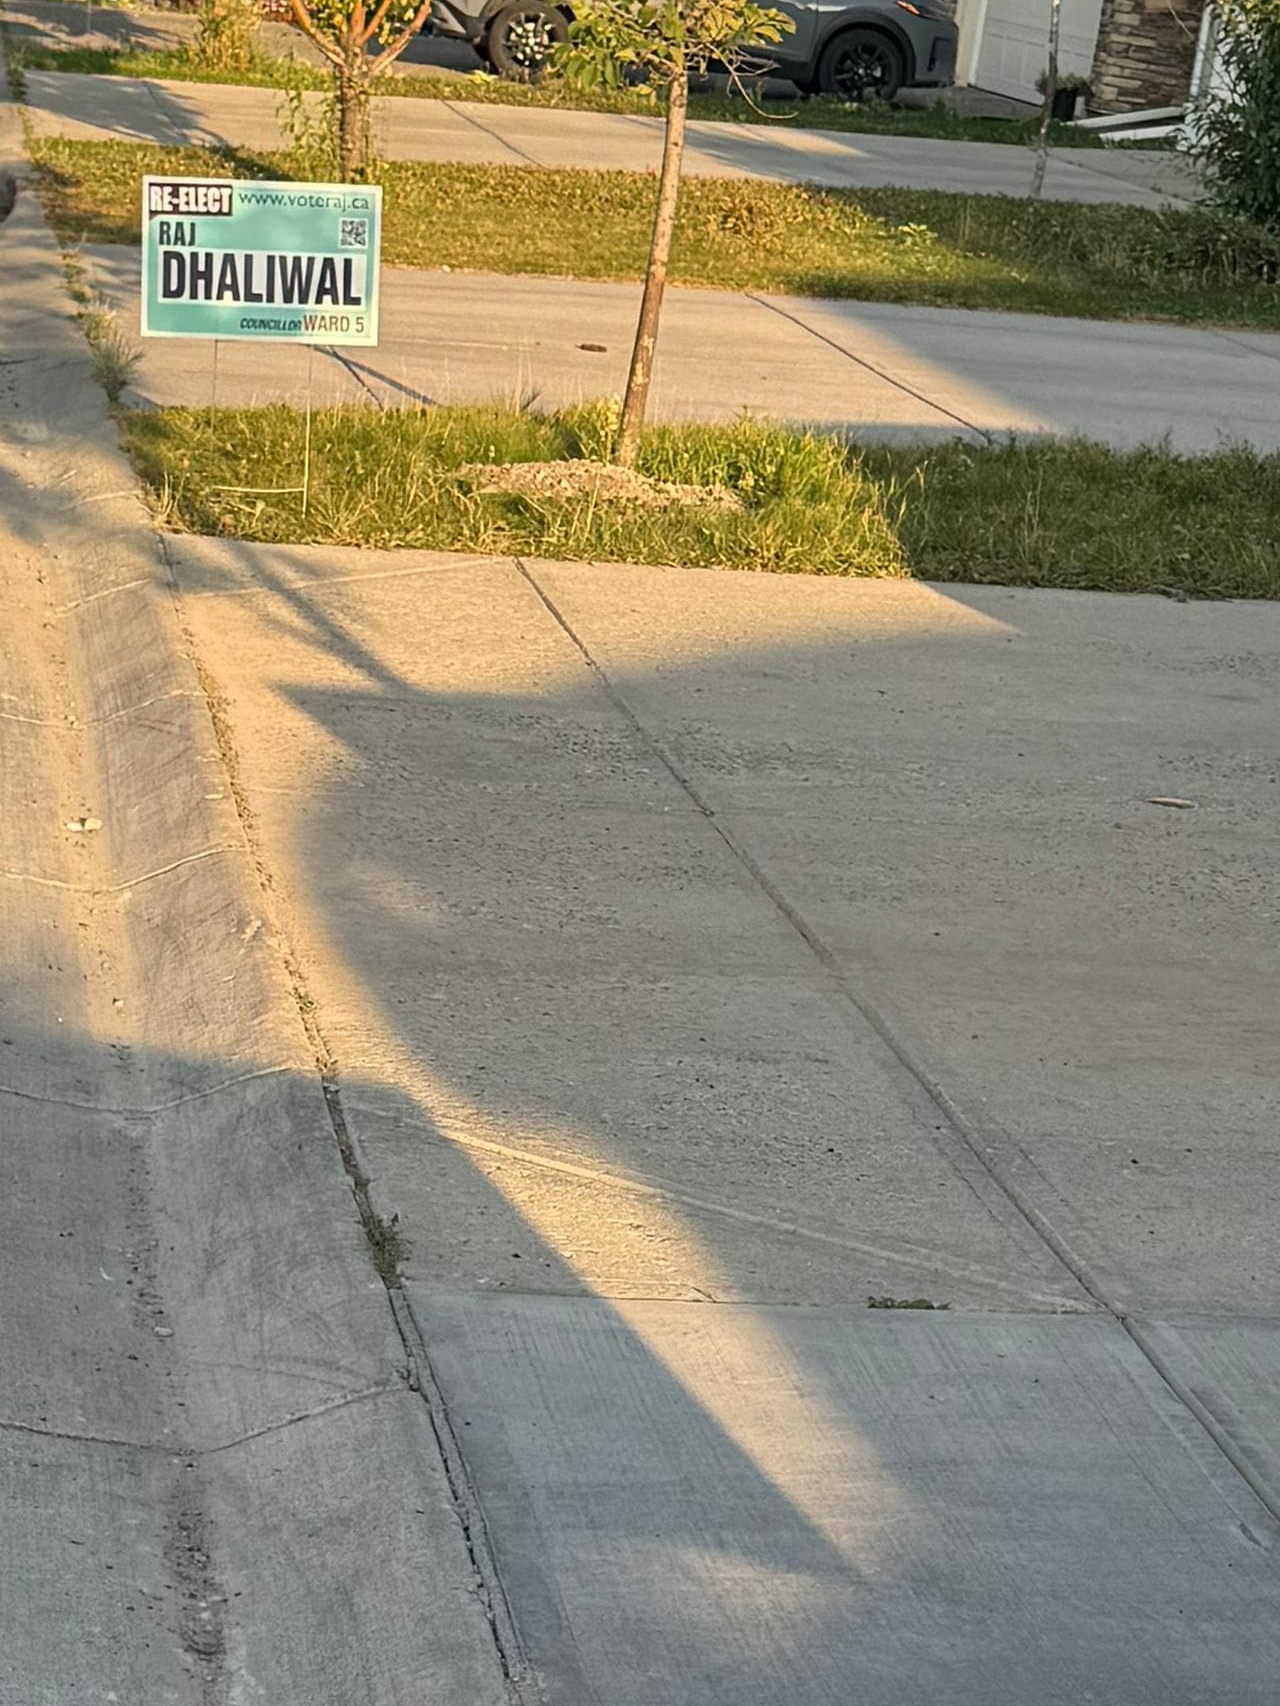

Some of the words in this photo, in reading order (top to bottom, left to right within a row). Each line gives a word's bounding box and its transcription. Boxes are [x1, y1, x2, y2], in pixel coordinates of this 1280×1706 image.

[150, 185, 232, 214] RE-ELECT
[239, 192, 369, 212] www.voteraj.ca
[159, 221, 196, 246] RAJ
[162, 251, 362, 306] DHALIWAL
[240, 317, 302, 331] COUNCILLOR
[303, 314, 350, 332] WARD
[356, 317, 364, 333] 5
